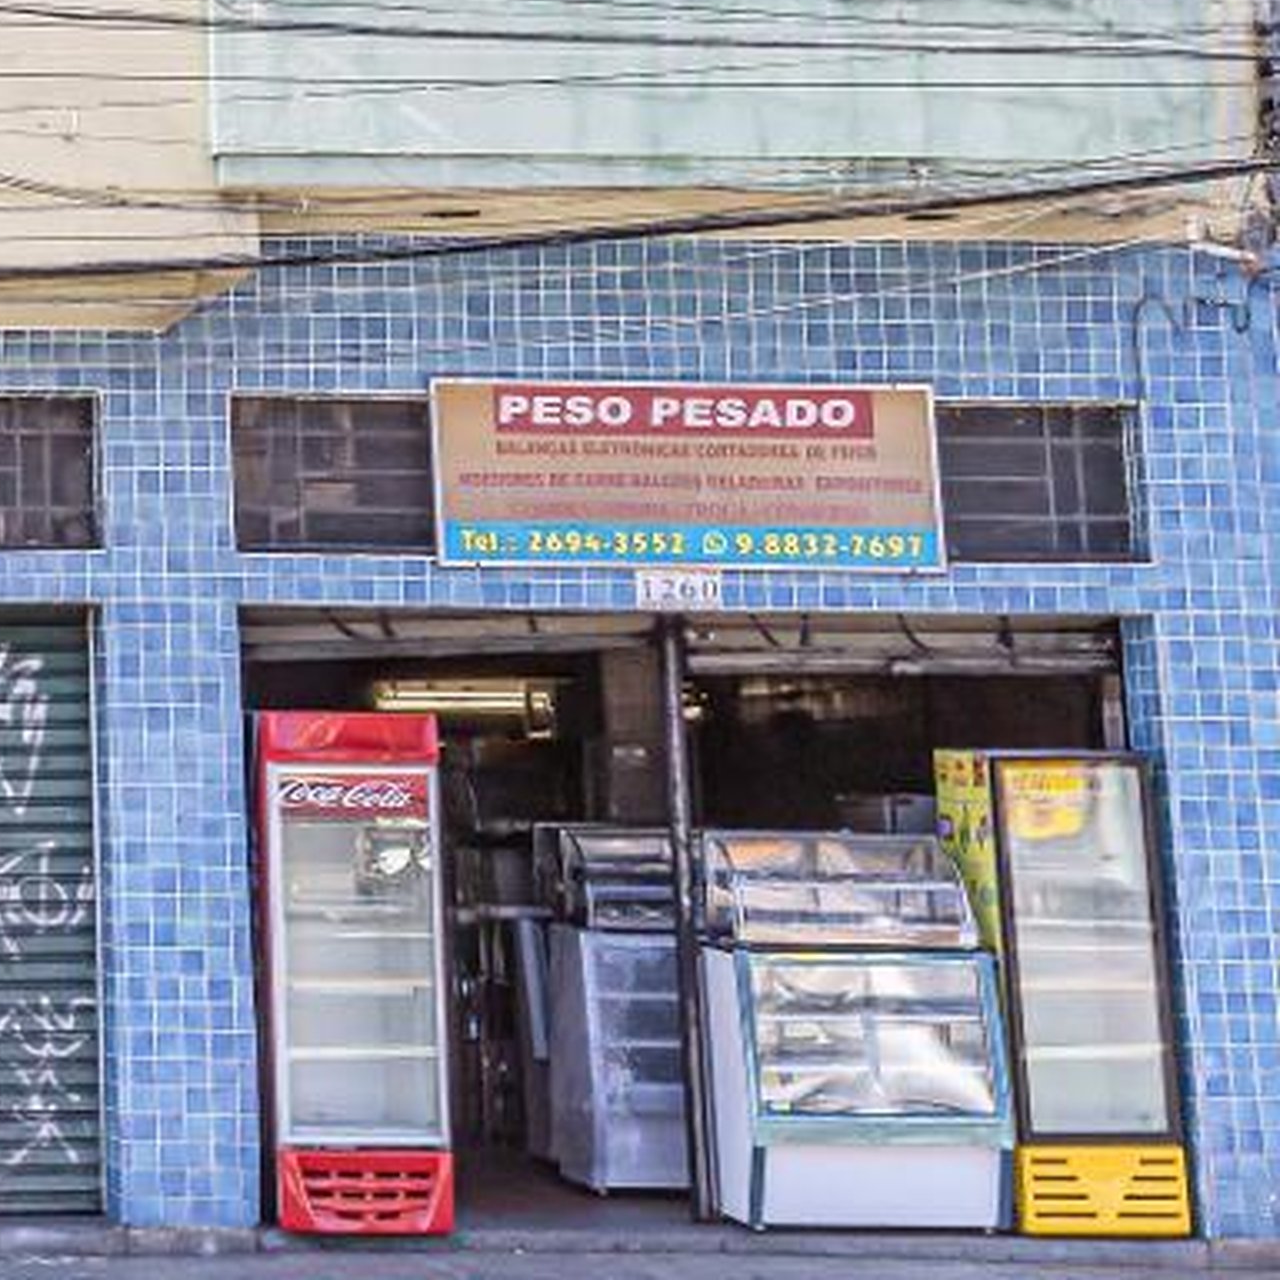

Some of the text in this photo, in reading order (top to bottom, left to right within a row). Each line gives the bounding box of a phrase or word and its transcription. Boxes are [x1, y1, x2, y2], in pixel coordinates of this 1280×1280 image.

[498, 395, 856, 428] PESO PESADO
[642, 577, 717, 599] 1260
